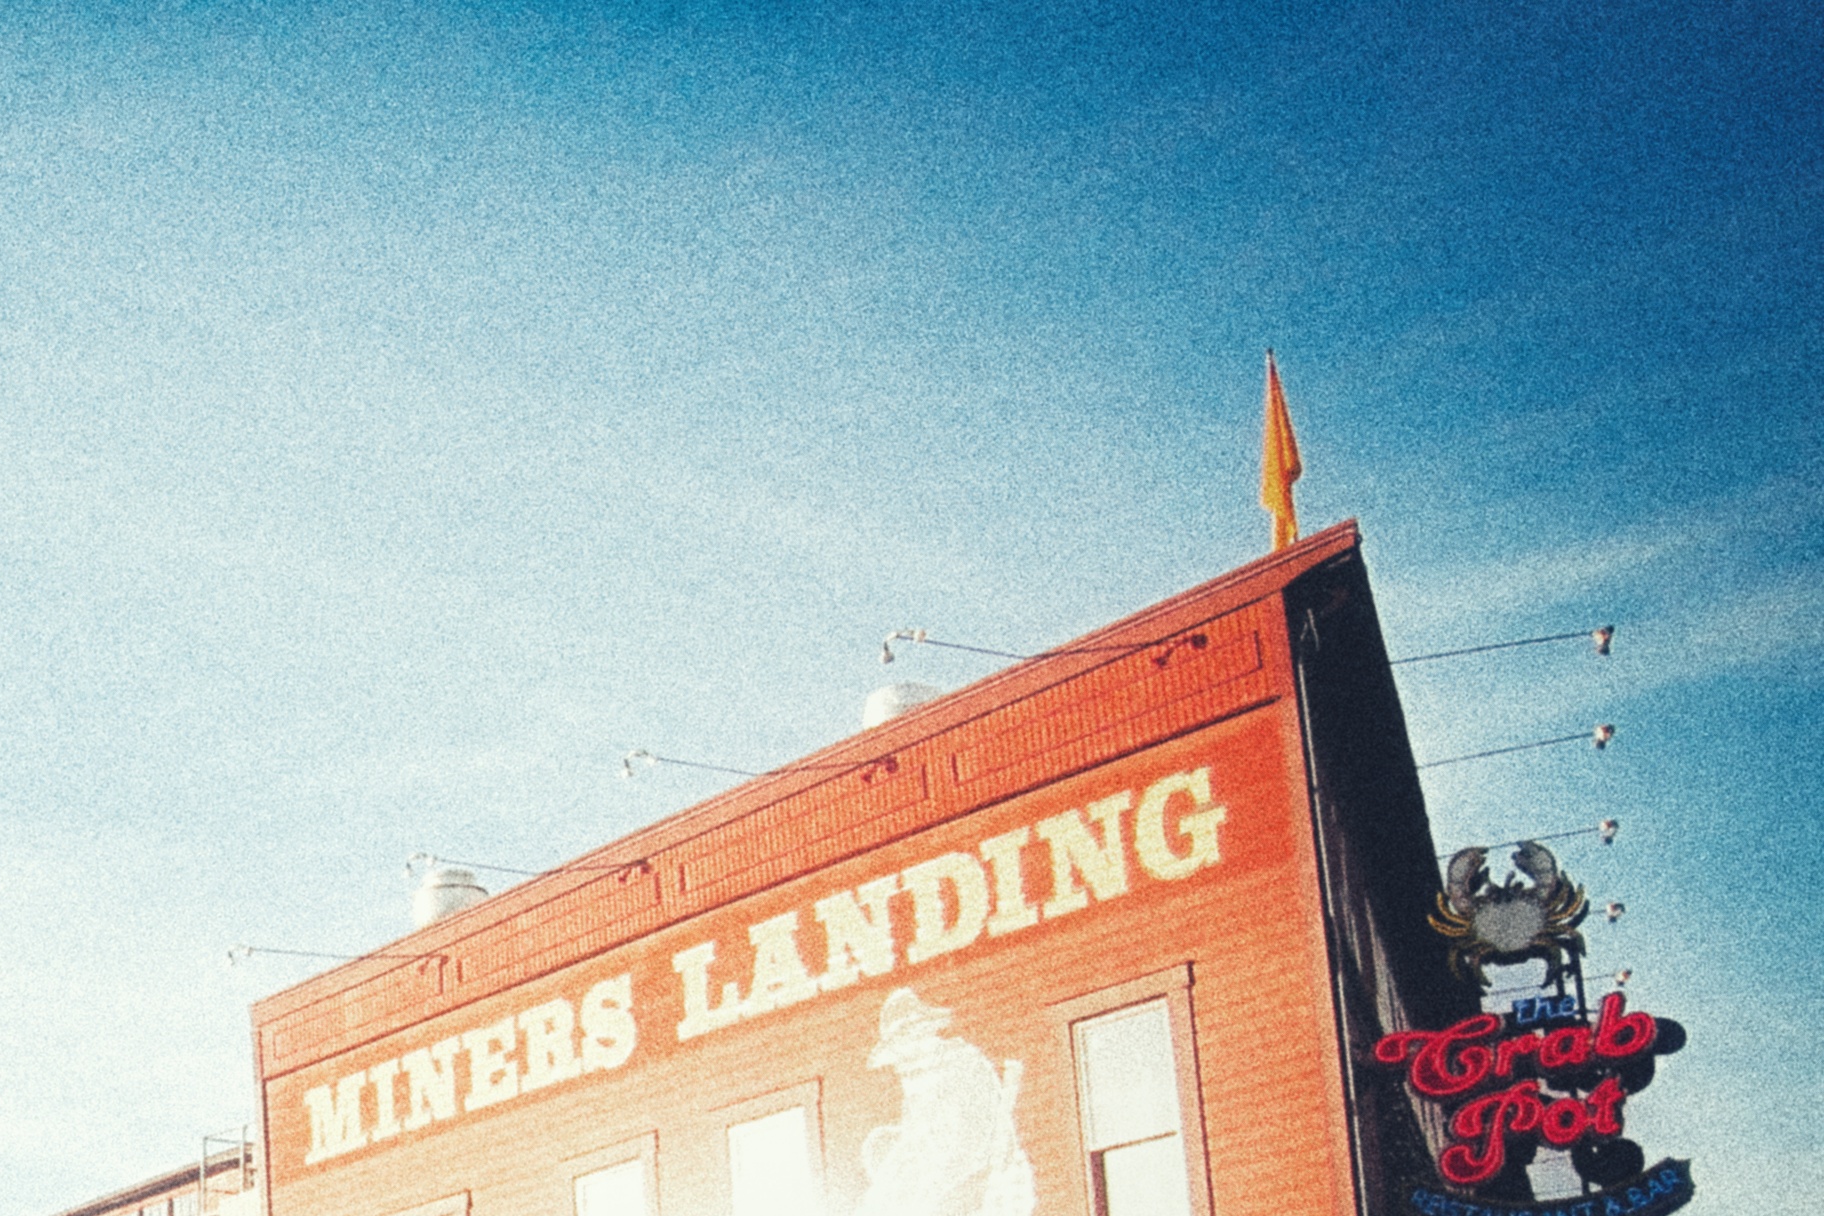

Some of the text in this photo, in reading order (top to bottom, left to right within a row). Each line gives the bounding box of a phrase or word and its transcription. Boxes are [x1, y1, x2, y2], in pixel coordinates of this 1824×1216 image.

[303, 765, 1228, 1165] MINERS LANDING
[1375, 990, 1657, 1096] Crab
[1440, 1074, 1626, 1184] Pot
[1625, 1168, 1683, 1214] BAR
